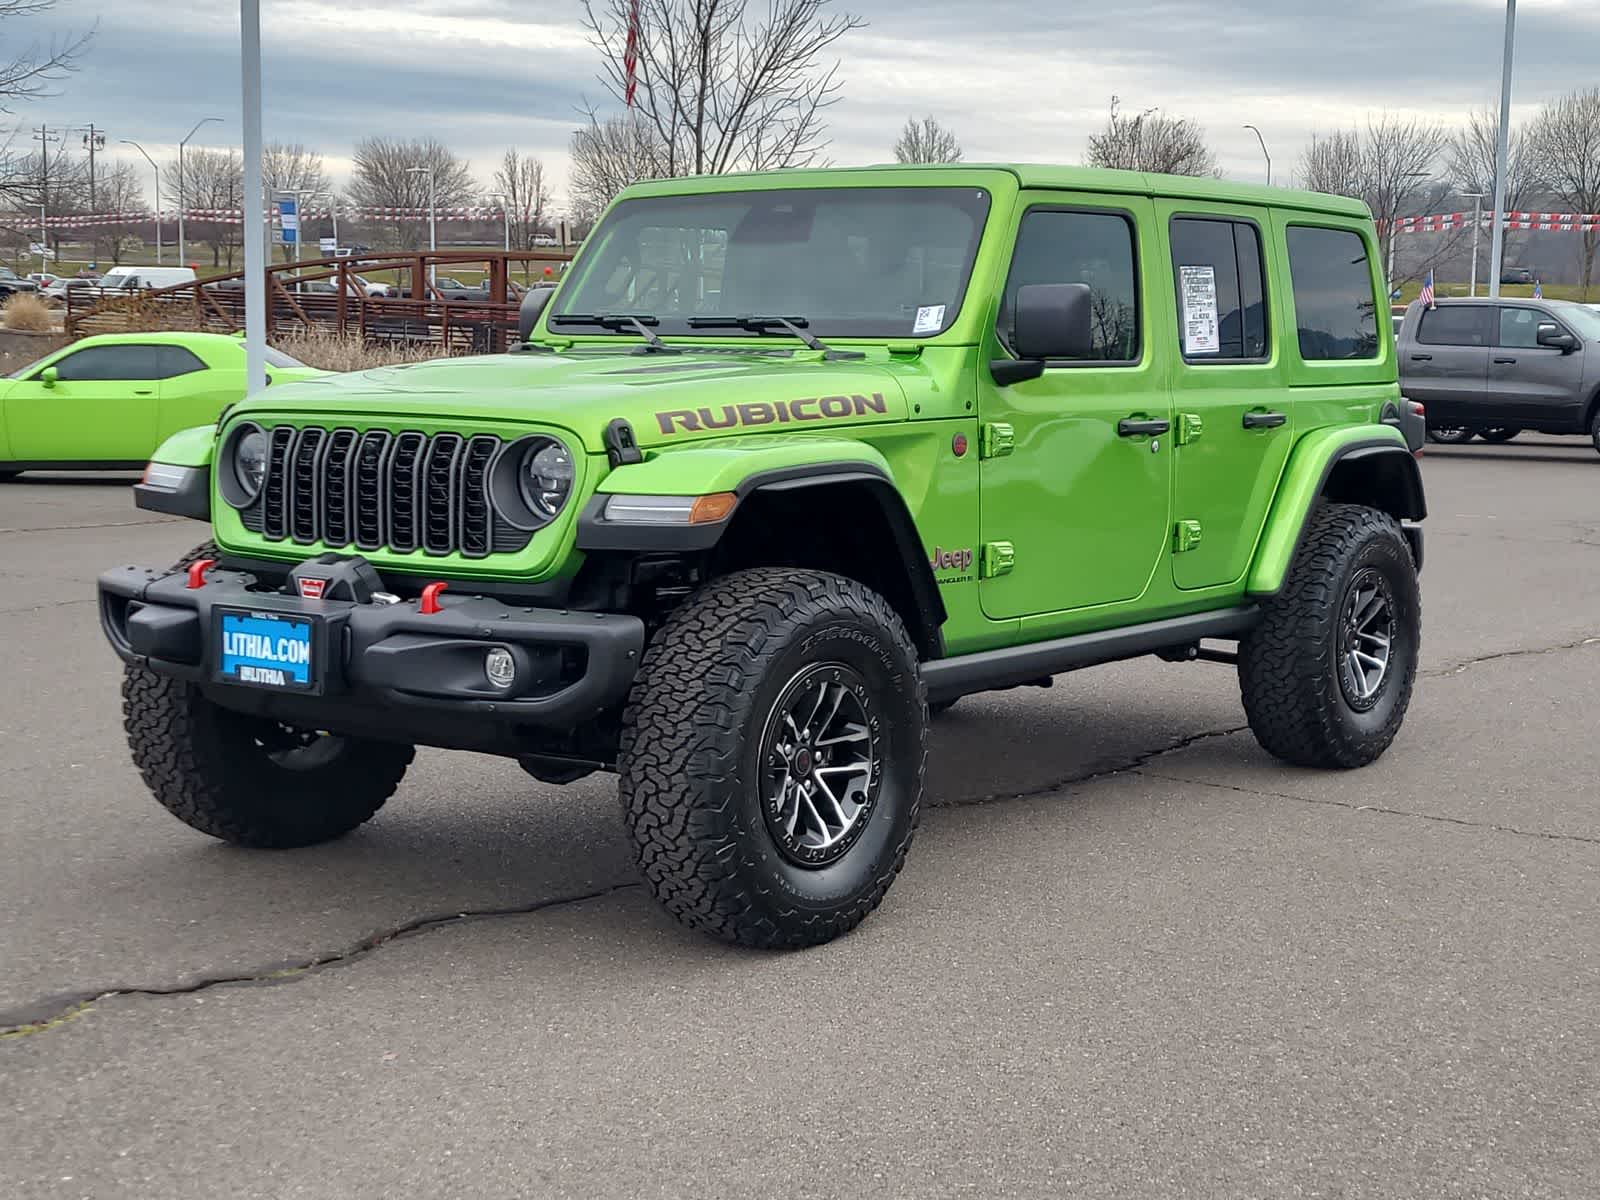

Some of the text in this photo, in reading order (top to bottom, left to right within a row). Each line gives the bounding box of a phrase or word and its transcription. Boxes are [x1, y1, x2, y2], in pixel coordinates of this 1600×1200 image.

[656, 393, 887, 434] RUBICON
[930, 546, 973, 572] Jeep
[223, 631, 310, 664] LITHIA.COM
